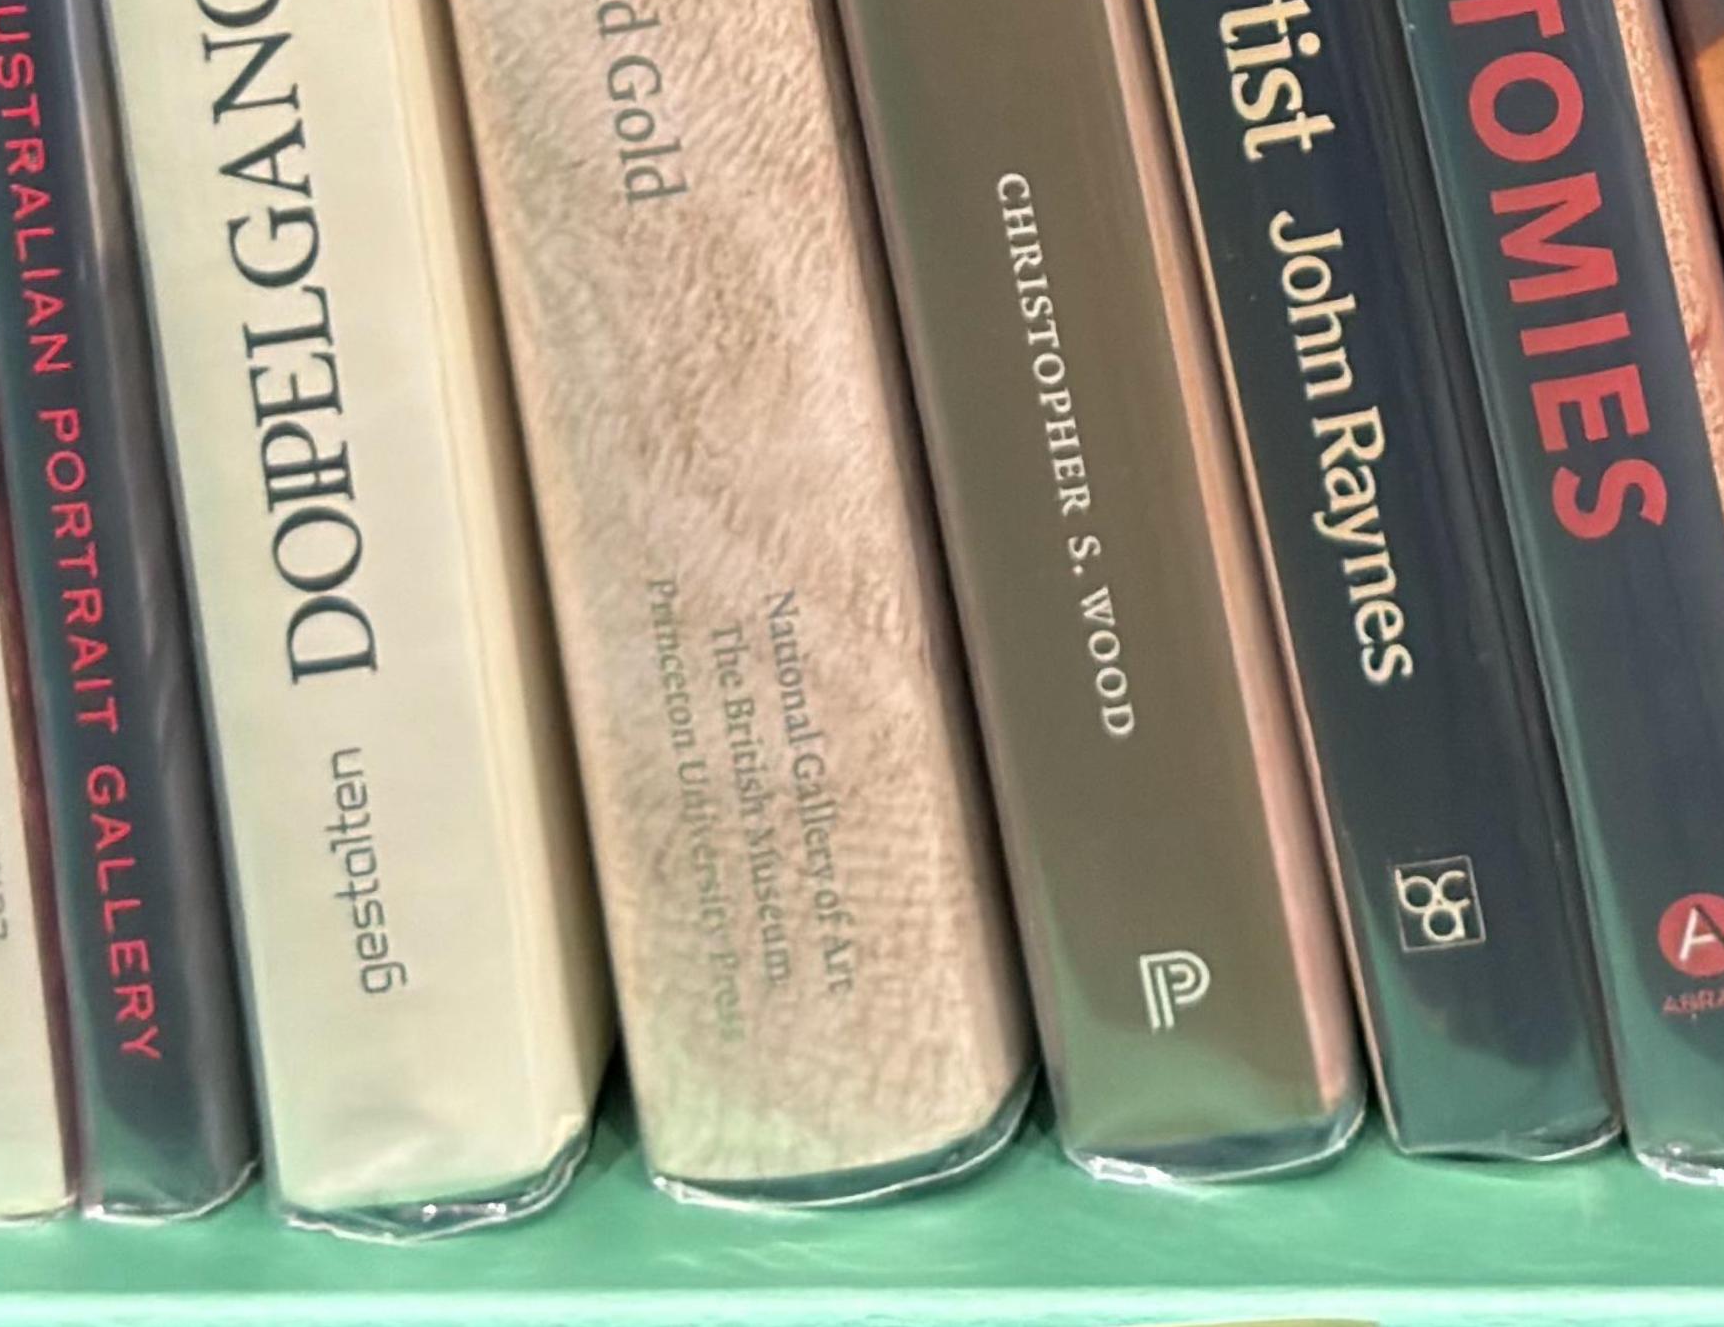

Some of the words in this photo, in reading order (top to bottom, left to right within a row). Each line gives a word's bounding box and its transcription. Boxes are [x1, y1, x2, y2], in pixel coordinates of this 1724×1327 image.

[606, 50, 689, 207] Gold
[995, 170, 1093, 521] CHRISTOPHER
[1268, 207, 1359, 402] John
[1068, 532, 1103, 577] S.
[1310, 404, 1417, 688] Raynes
[39, 405, 121, 734] PORTRAIT
[86, 763, 163, 1061] GALLERY
[646, 578, 699, 750] Princeton
[710, 620, 750, 690] The
[764, 587, 825, 746] National
[1079, 581, 1137, 739] WOOD
[723, 695, 776, 820] British
[792, 751, 838, 884] Gallery
[324, 746, 407, 996] gestalten
[748, 825, 794, 988] Museum
[813, 885, 855, 924] of
[819, 932, 855, 997] Art
